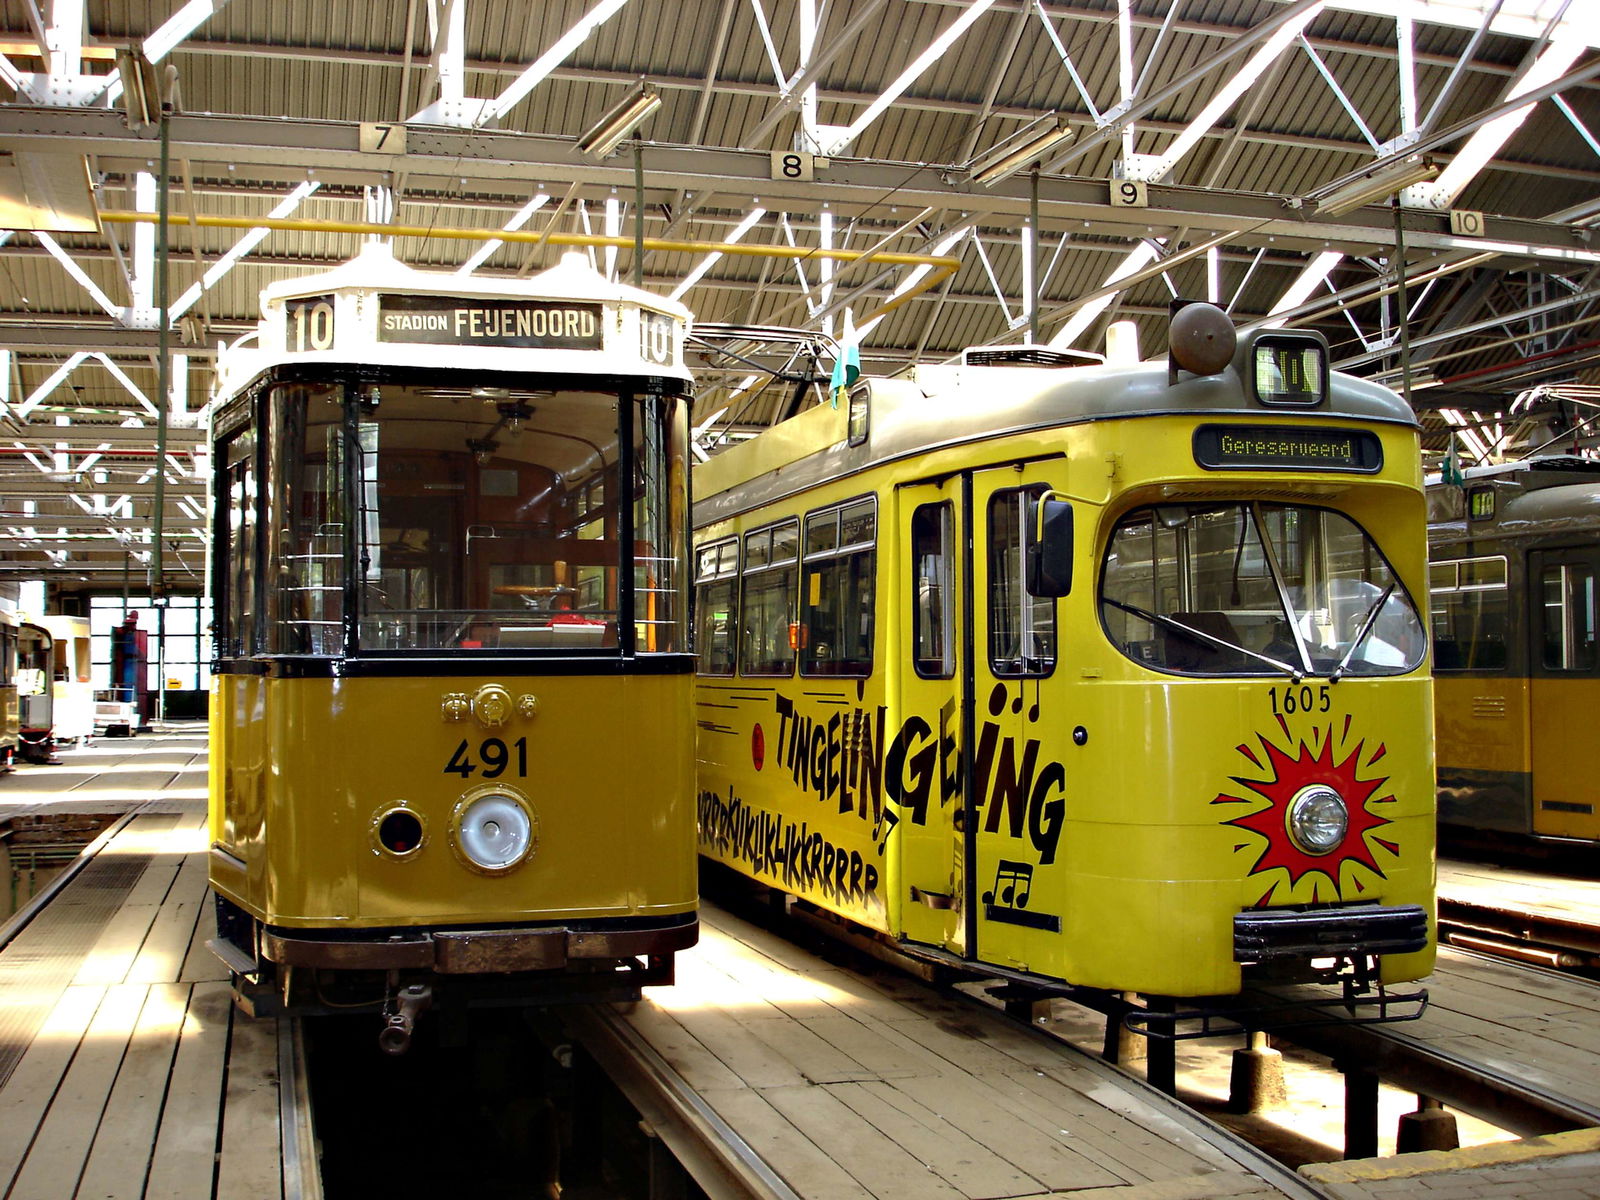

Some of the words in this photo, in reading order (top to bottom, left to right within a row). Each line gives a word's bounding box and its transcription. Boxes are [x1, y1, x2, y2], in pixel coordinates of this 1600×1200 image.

[375, 126, 392, 150] 7
[783, 154, 802, 178] 8
[1120, 182, 1138, 205] 9
[1456, 212, 1478, 233] 10
[294, 302, 333, 351] 10
[385, 314, 448, 331] STADION
[640, 310, 669, 364] 10
[1221, 435, 1351, 458] Gereserveerd
[1268, 685, 1331, 714] 1605
[443, 736, 527, 779] 491
